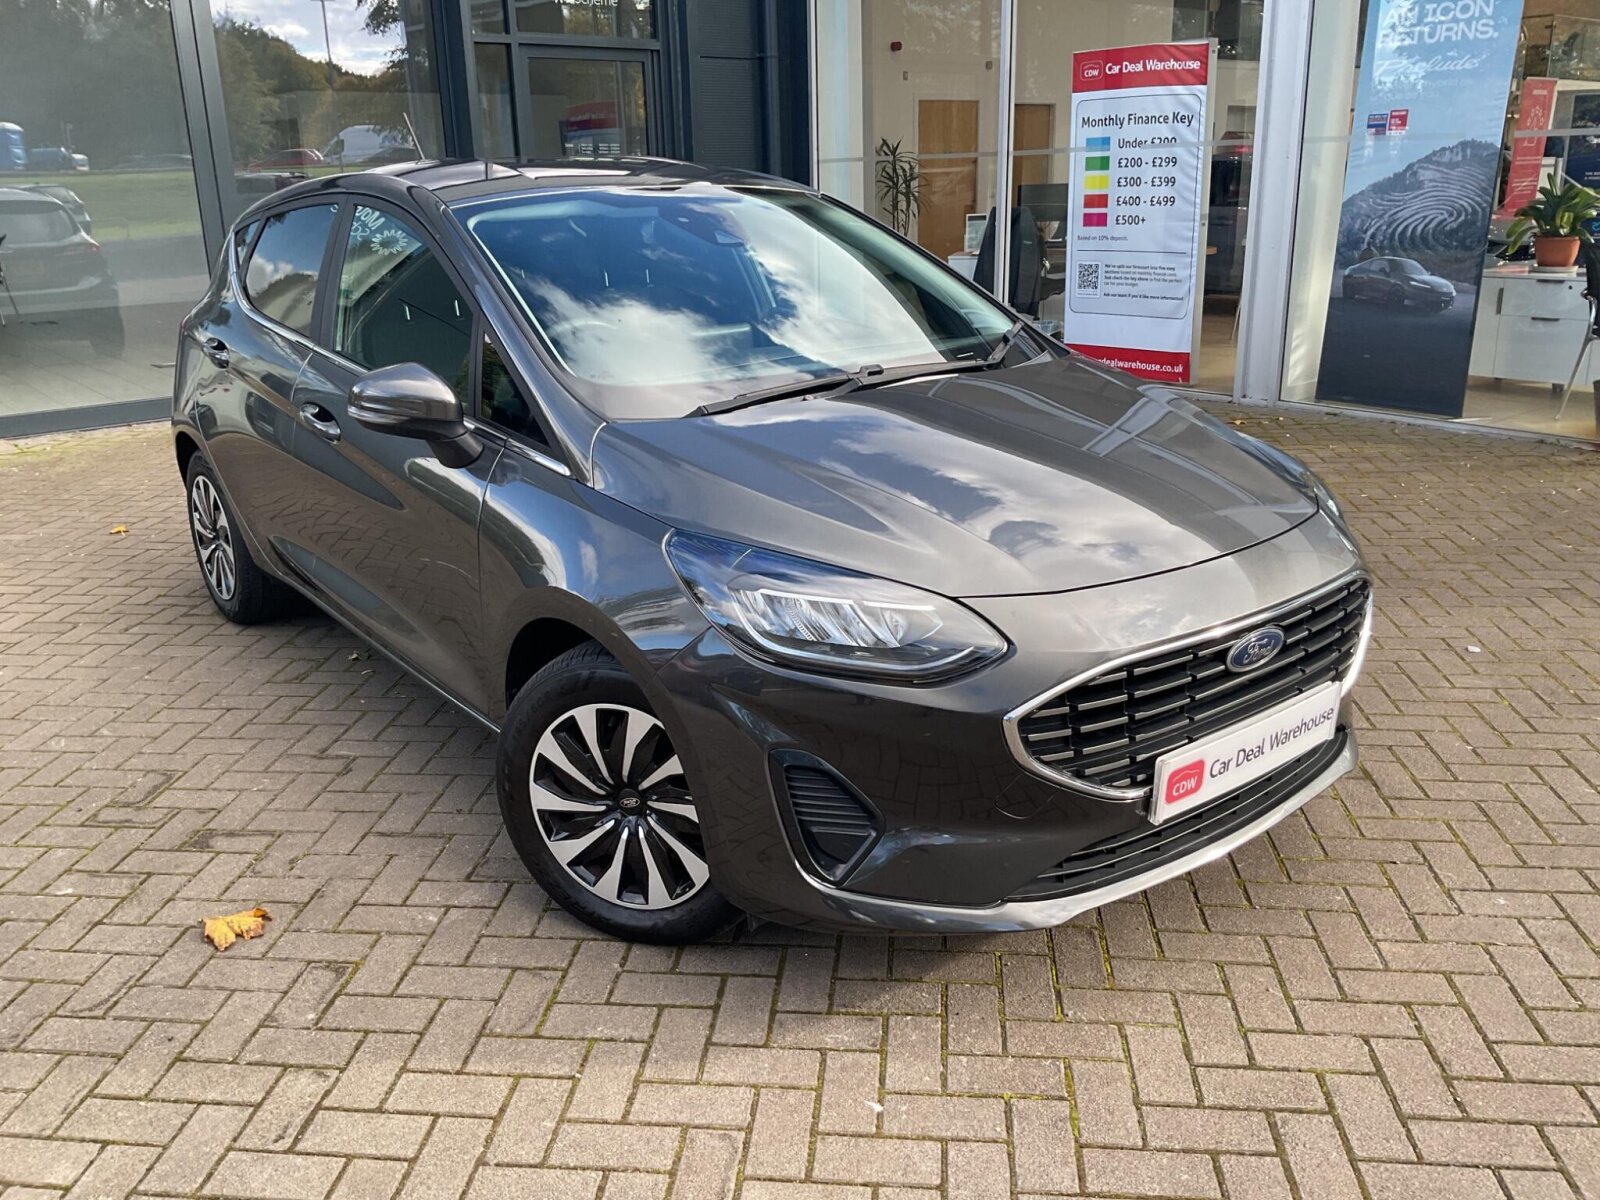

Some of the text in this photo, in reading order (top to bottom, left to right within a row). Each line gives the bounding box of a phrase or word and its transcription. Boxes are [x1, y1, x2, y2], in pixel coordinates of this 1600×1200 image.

[1423, 0, 1494, 22] ICON
[1084, 69, 1100, 78] CDW
[1105, 58, 1201, 75] Car Deal Warehouse
[1081, 111, 1194, 129] Monthly Finance Key
[1118, 137, 1148, 149] Under
[1117, 157, 1143, 168] £200
[1152, 156, 1178, 168] £299
[1117, 177, 1142, 187] £300
[1150, 176, 1176, 187] £399
[1116, 196, 1141, 206] £400
[1150, 195, 1176, 206] £499
[1115, 214, 1146, 225] £500+
[1243, 638, 1275, 665] Ford
[1209, 707, 1334, 779] Car Deal Warehouse
[1172, 775, 1198, 797] CDW
